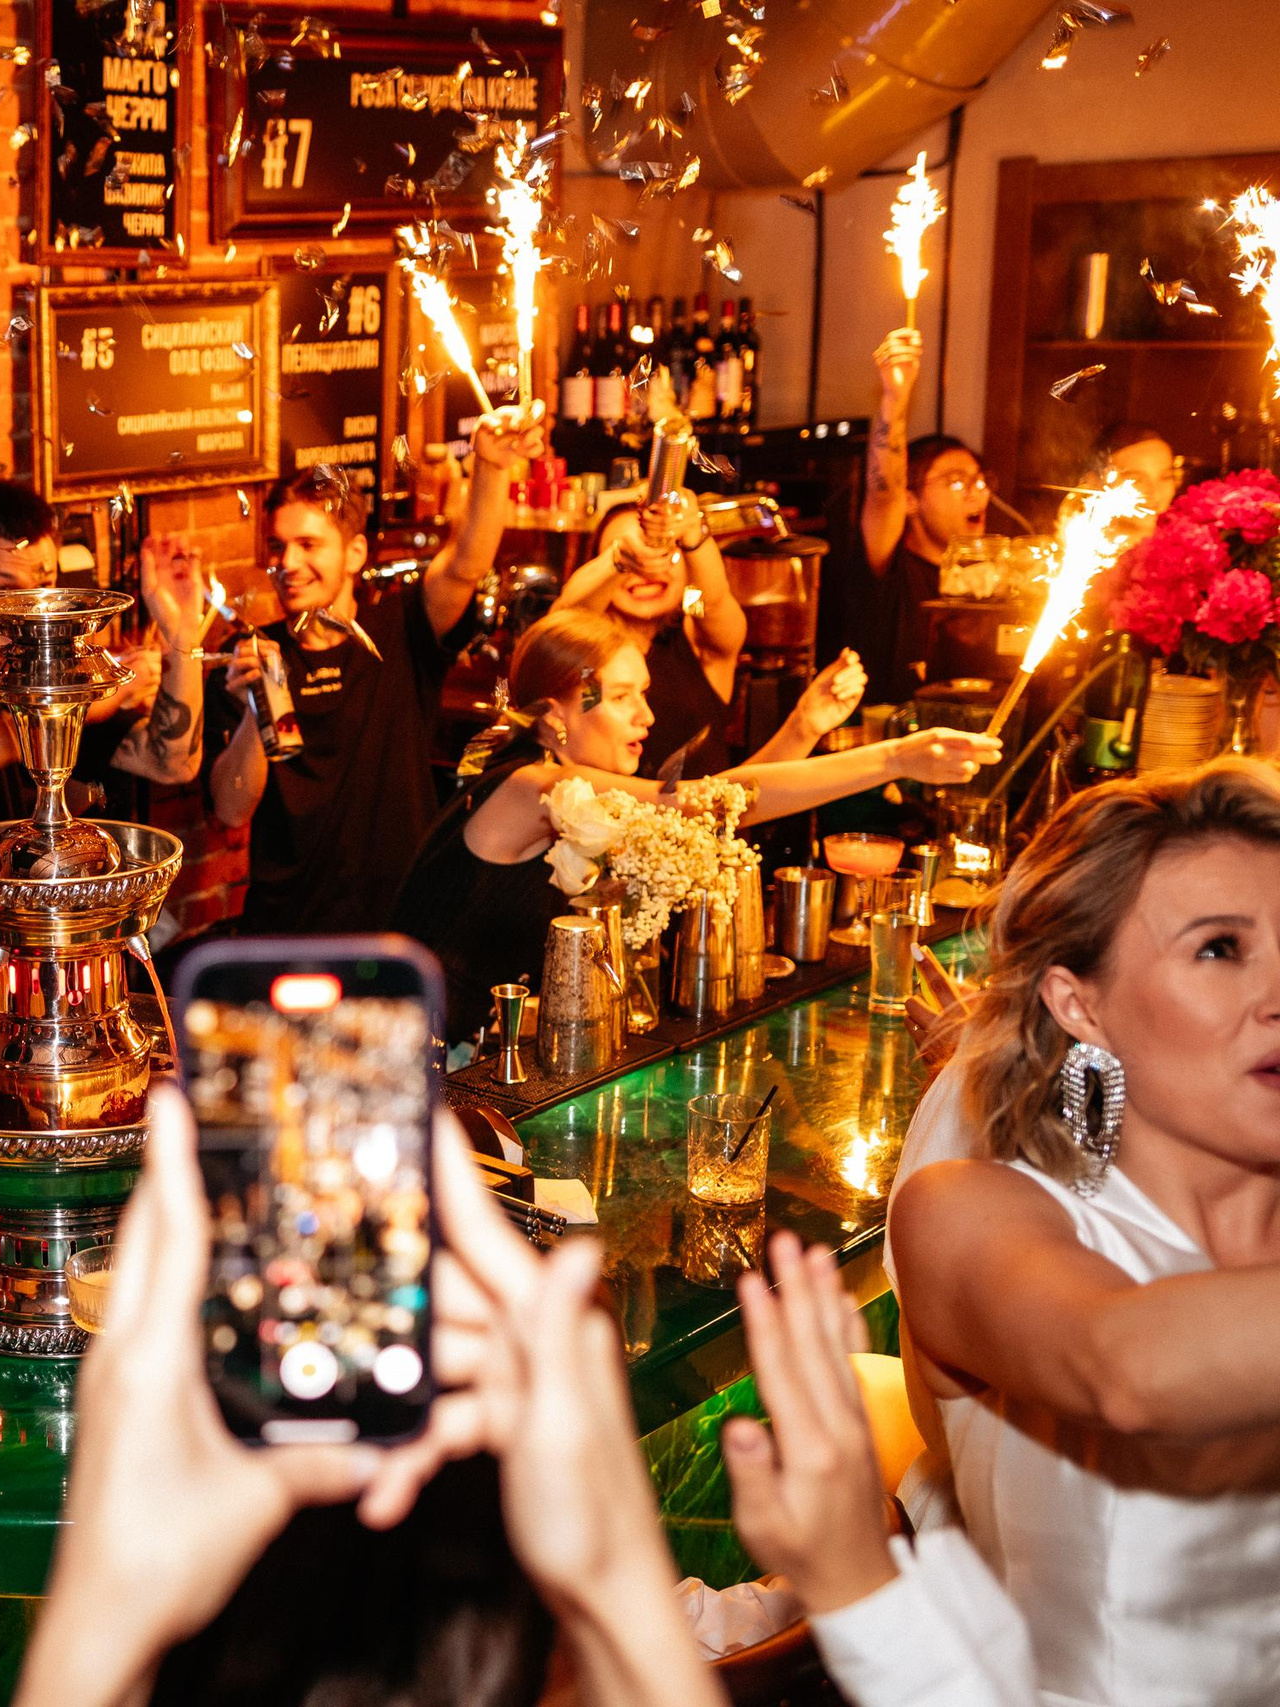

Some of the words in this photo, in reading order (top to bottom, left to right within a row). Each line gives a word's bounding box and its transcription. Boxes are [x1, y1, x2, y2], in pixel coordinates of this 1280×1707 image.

[102, 56, 167, 95] МАРГО
[105, 94, 167, 131] ЧЕРРИ
[261, 118, 313, 189] #7
[122, 212, 166, 237] ЧЕРРИ
[347, 285, 380, 335] #6
